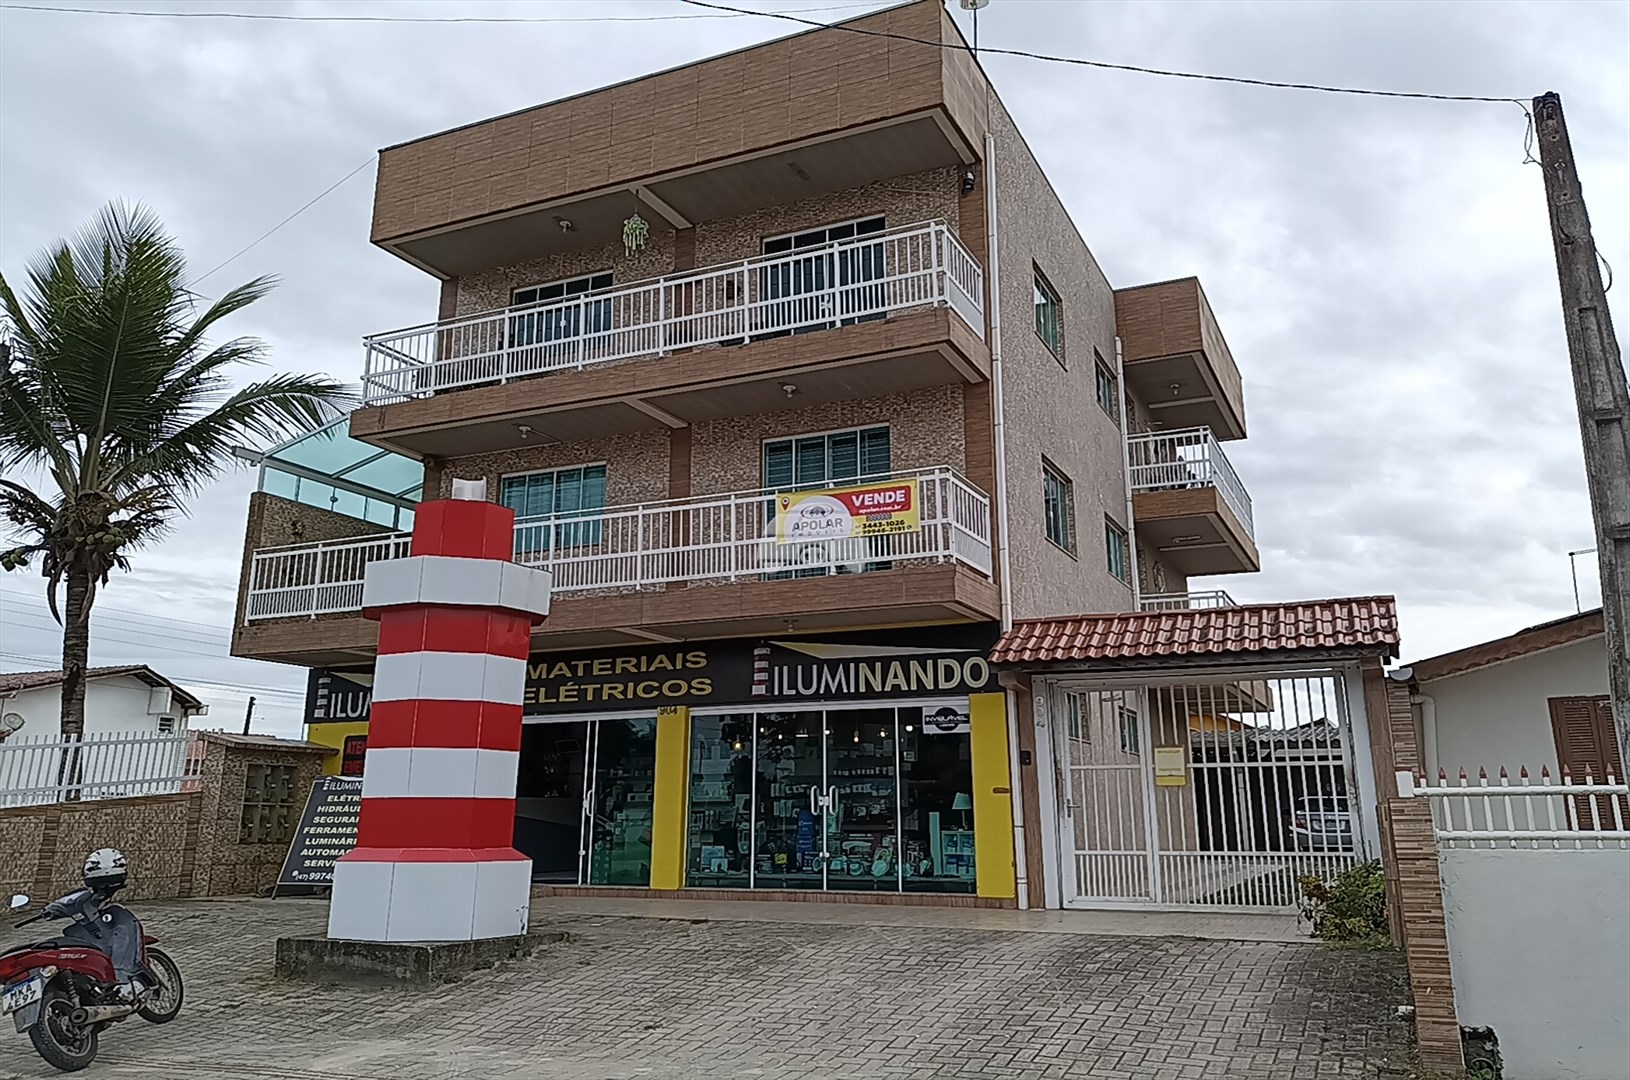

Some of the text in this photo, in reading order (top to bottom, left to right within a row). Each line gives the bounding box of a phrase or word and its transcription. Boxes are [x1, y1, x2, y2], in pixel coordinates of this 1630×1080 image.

[851, 490, 906, 507] VENDE
[791, 518, 844, 532] APOLAR
[862, 520, 906, 529] 3443-1026
[528, 651, 708, 680] MATERIAIS
[774, 656, 990, 696] ILUMINANDO
[524, 677, 713, 703] ELÉTRICOS
[660, 705, 678, 715] 904
[303, 859, 336, 867] SERVI
